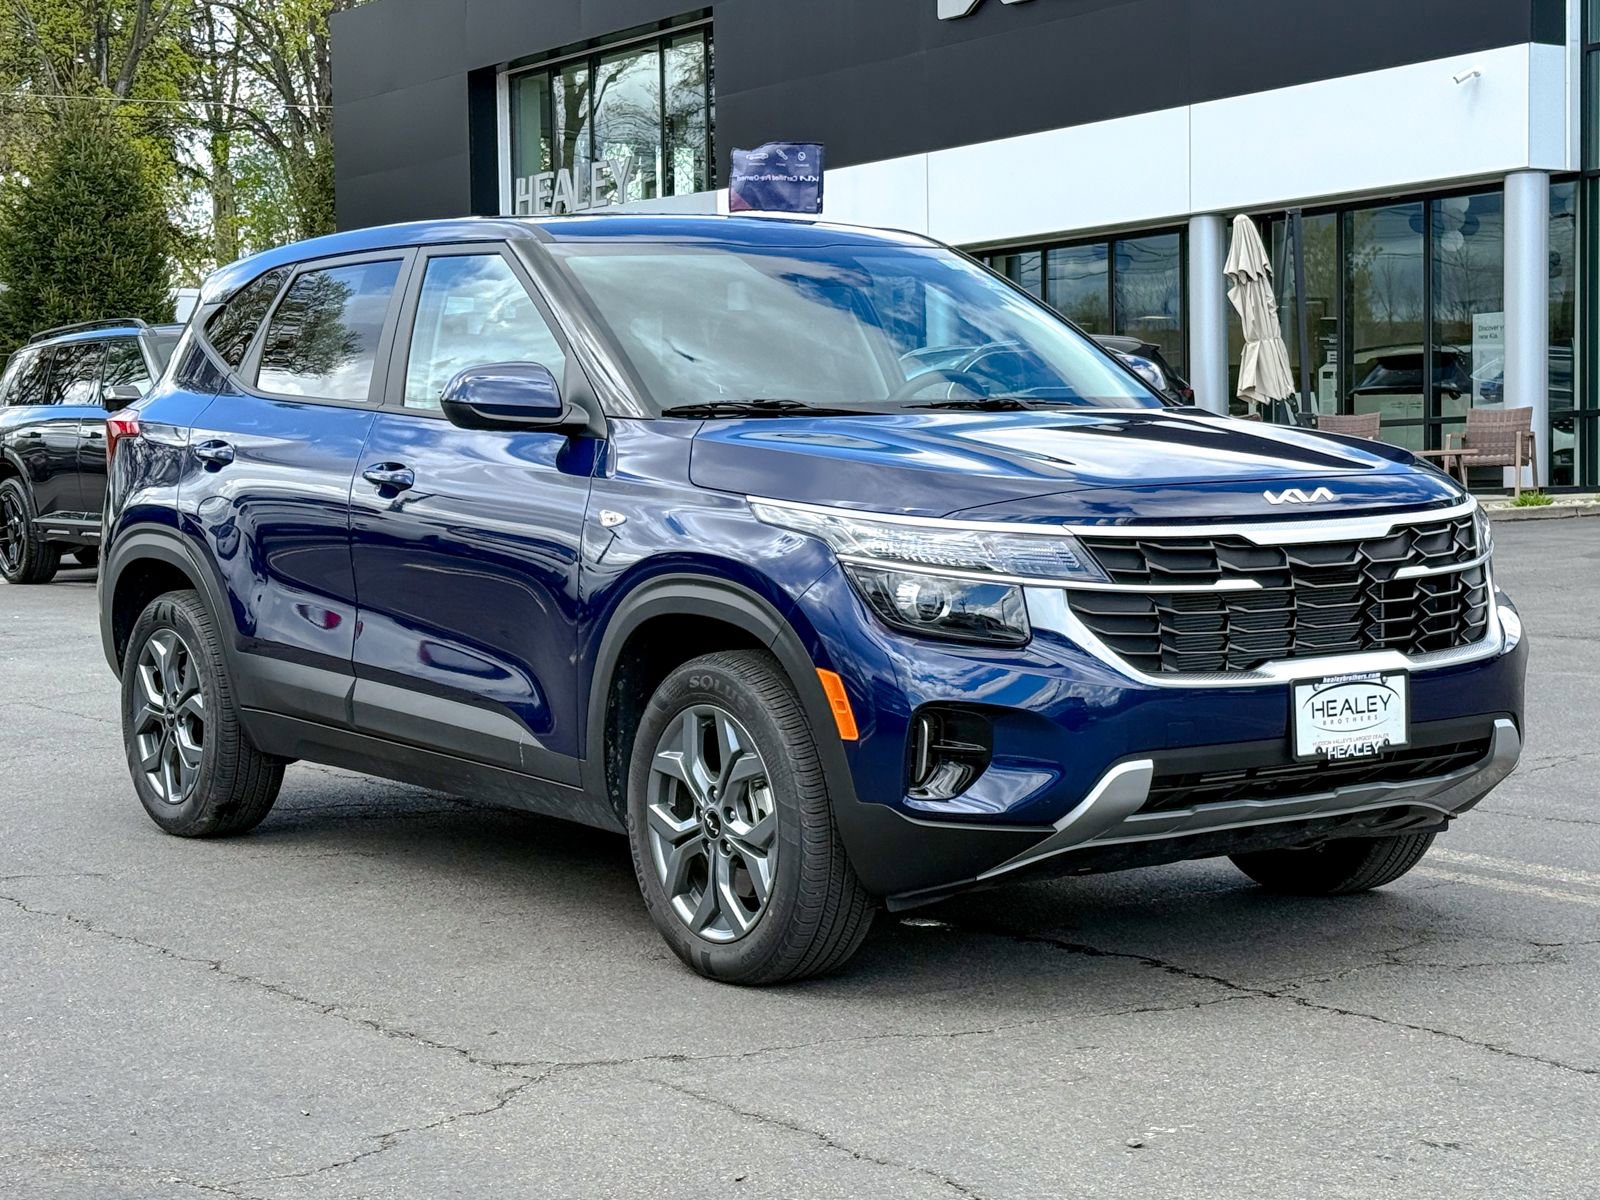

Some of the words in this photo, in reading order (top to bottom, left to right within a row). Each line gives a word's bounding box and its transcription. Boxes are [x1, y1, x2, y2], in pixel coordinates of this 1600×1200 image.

[515, 156, 632, 214] HEALEY
[1263, 487, 1334, 504] KIA
[1323, 673, 1381, 684] healeybrothers.com
[689, 675, 748, 712] SOLUS
[1311, 694, 1392, 719] HEALEY
[1323, 714, 1378, 726] BROTHERS
[1327, 741, 1380, 760] HEALEY
